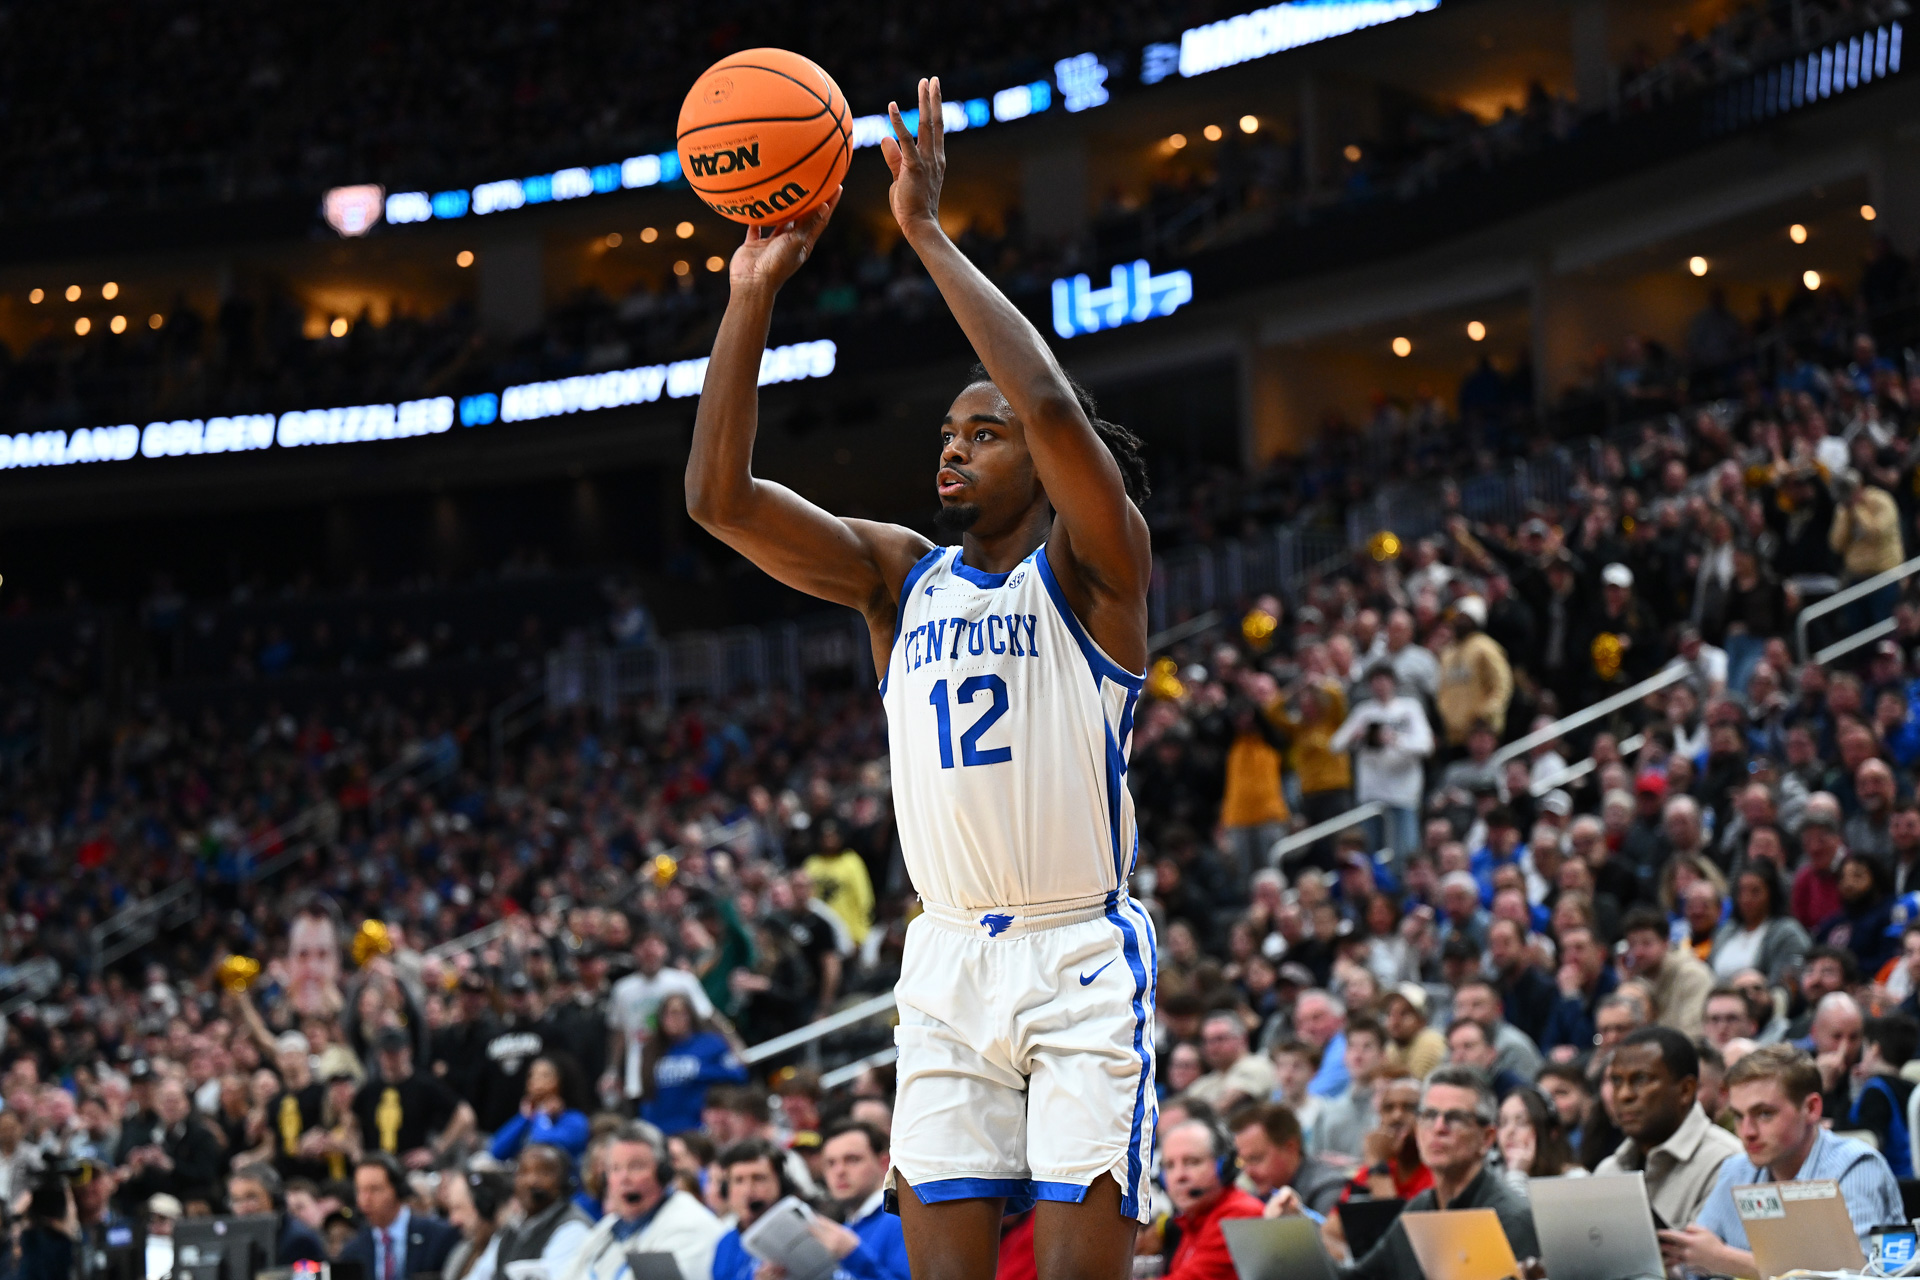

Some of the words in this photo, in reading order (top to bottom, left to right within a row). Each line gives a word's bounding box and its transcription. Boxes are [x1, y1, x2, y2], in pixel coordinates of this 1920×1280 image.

[688, 142, 761, 177] NCAA
[700, 182, 811, 219] Wilson
[141, 413, 276, 458] GOLDEN
[276, 396, 455, 448] GRIZZLIES
[500, 364, 667, 423] KENTUCKY
[929, 673, 1012, 769] 12
